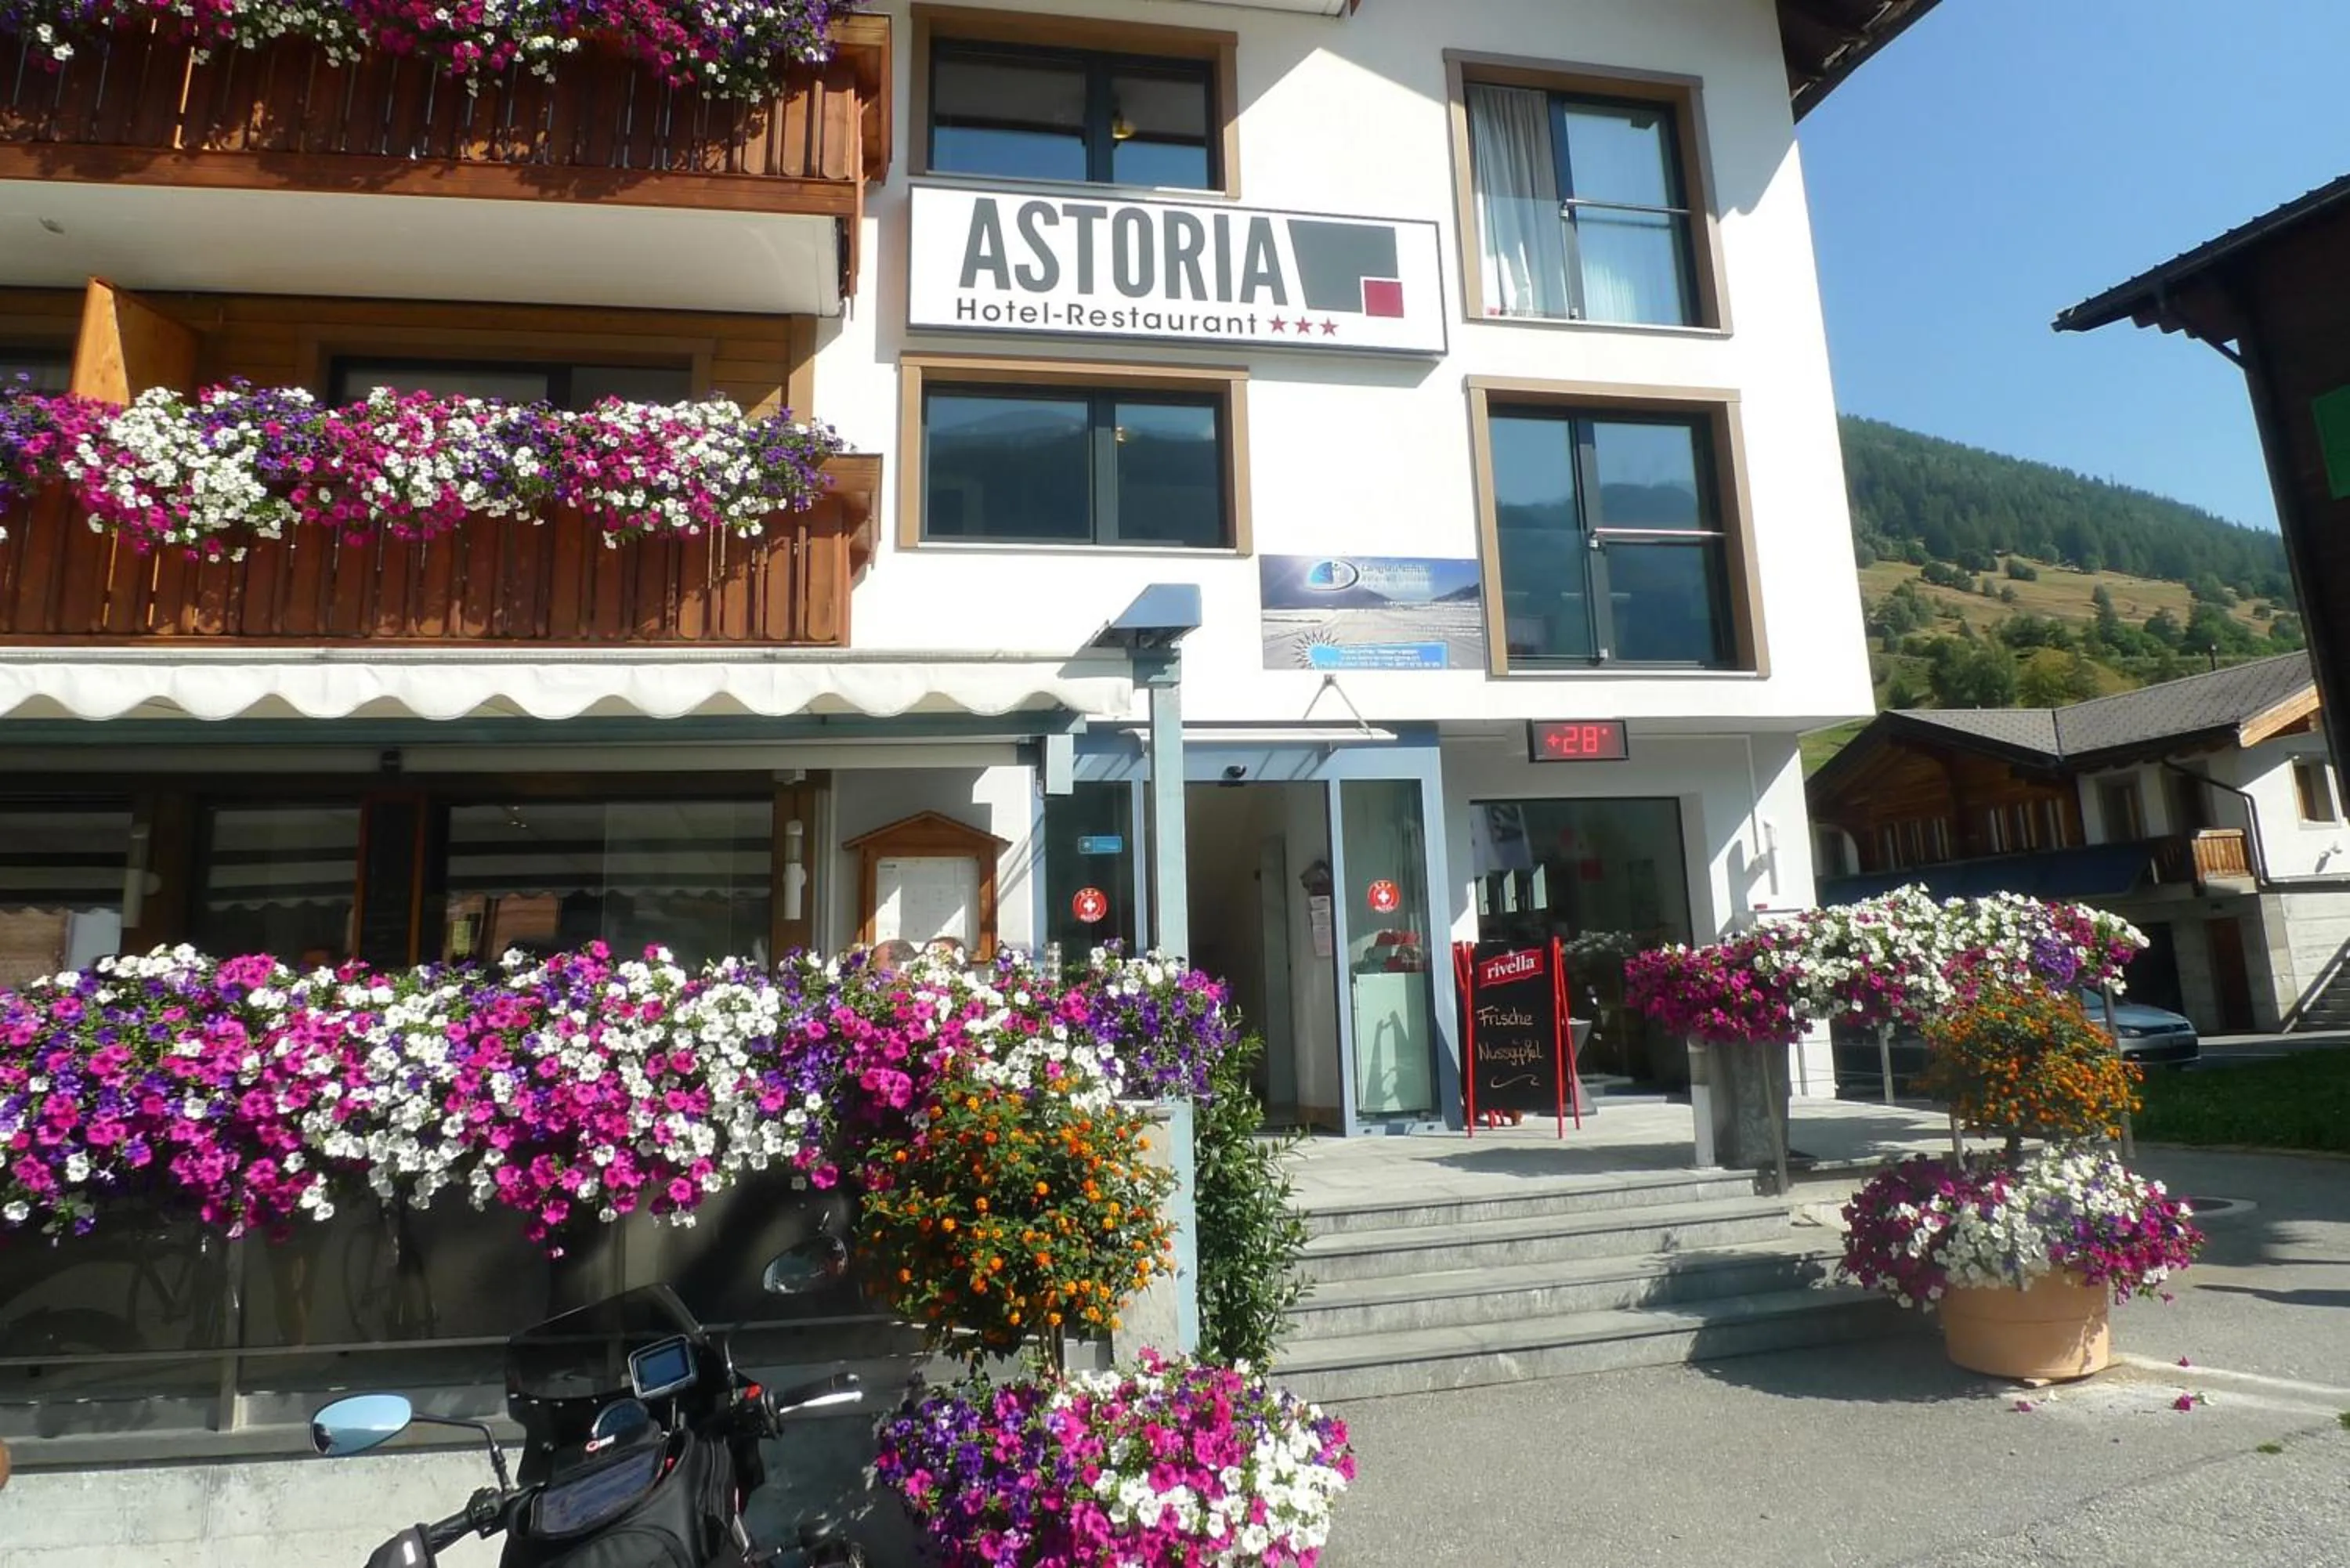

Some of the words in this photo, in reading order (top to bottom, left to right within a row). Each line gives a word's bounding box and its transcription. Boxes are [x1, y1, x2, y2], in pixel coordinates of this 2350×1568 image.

[959, 197, 1289, 306] ASTORIA
[956, 298, 1257, 335] Hotel-Restaurant
[1488, 955, 1535, 979] rivella
[1477, 1006, 1535, 1028] Frische
